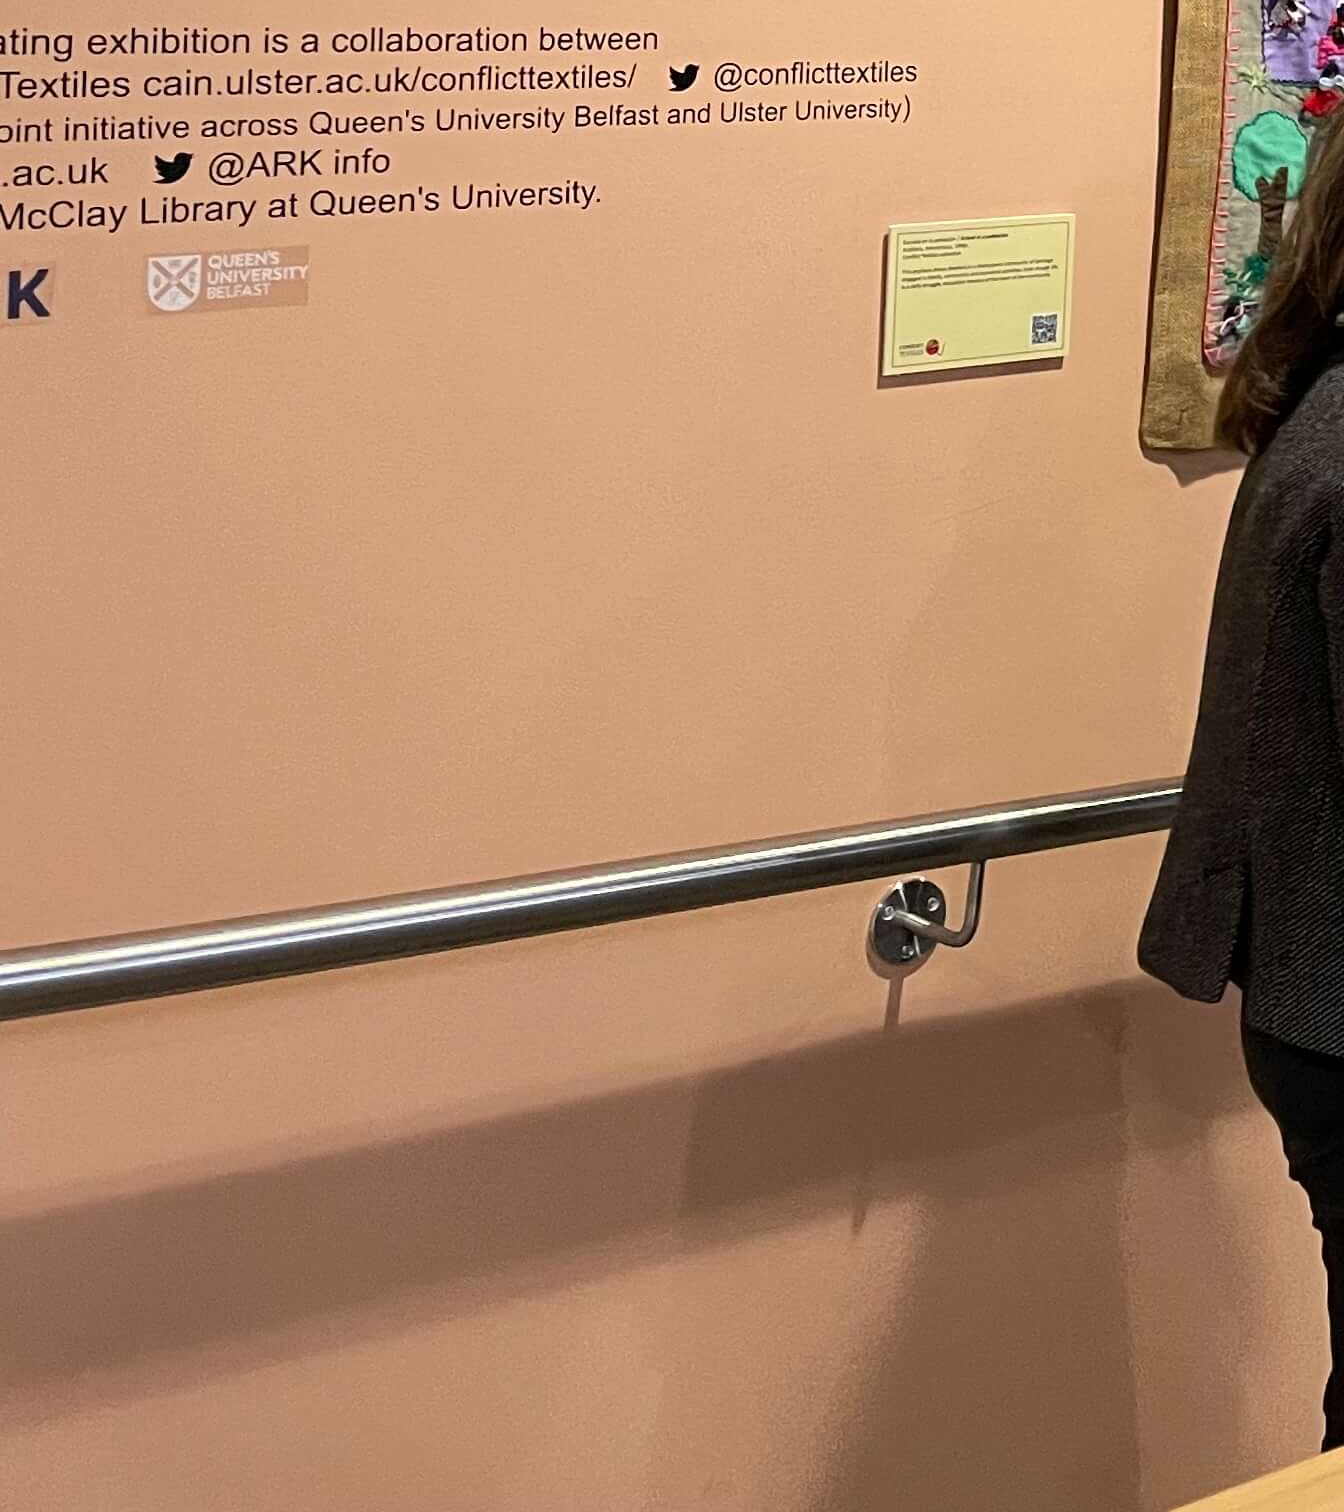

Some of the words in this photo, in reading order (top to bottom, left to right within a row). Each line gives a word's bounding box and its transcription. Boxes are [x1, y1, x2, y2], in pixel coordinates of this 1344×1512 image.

[88, 27, 250, 54] exhibition
[264, 27, 288, 54] is
[301, 34, 319, 54] a
[331, 27, 528, 53] collaboration
[539, 28, 658, 52] between
[0, 71, 130, 99] Textiles
[143, 63, 638, 97] cain.ulster.ac.uk/conflicttextiles/
[714, 61, 918, 92] @conflicttextiles
[64, 115, 190, 142] initiative
[201, 118, 298, 138] across
[309, 110, 425, 138] Queen's
[437, 107, 566, 133] University
[575, 103, 660, 128] Belfast
[667, 102, 710, 125] and
[721, 100, 788, 124] Ulster
[796, 95, 911, 124] University)
[2, 157, 109, 187] .ac.uk
[209, 149, 323, 187] @ARK
[334, 148, 391, 175] info
[0, 200, 127, 234] McClay
[141, 197, 257, 228] Library
[268, 193, 299, 219] at
[310, 186, 440, 216] Queen's
[452, 179, 601, 210] University.
[206, 265, 309, 285] UNIVERSITY
[207, 251, 281, 269] QUEEN'S
[8, 269, 50, 319] K
[206, 284, 271, 300] BELFAST
